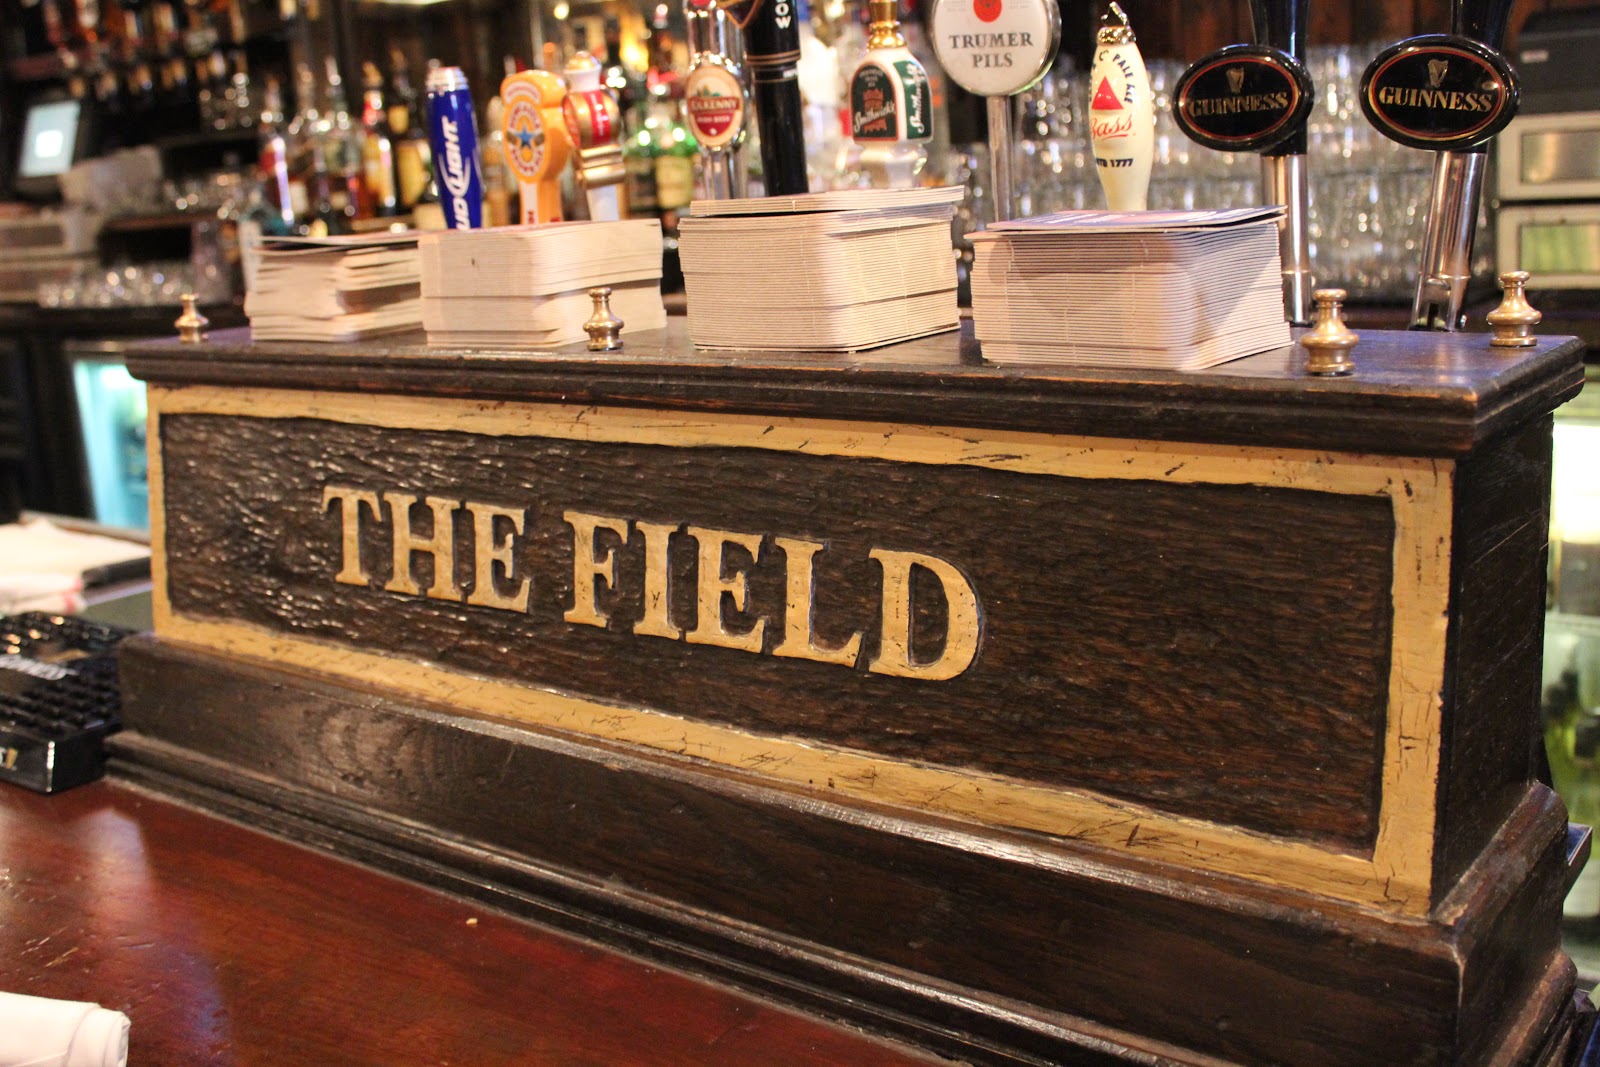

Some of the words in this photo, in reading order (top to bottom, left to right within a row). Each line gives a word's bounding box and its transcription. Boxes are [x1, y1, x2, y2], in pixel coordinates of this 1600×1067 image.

[774, 0, 792, 29] OW
[948, 32, 1034, 49] TRUMER
[972, 52, 1013, 68] PILS
[1112, 53, 1134, 79] PALE
[1187, 91, 1289, 118] GUINNESS
[1378, 86, 1492, 112] GUINNESS
[441, 115, 466, 194] LIGHT
[1110, 158, 1133, 168] 1777
[453, 197, 471, 230] UD
[321, 485, 532, 614] THE
[563, 510, 985, 682] FIELD
